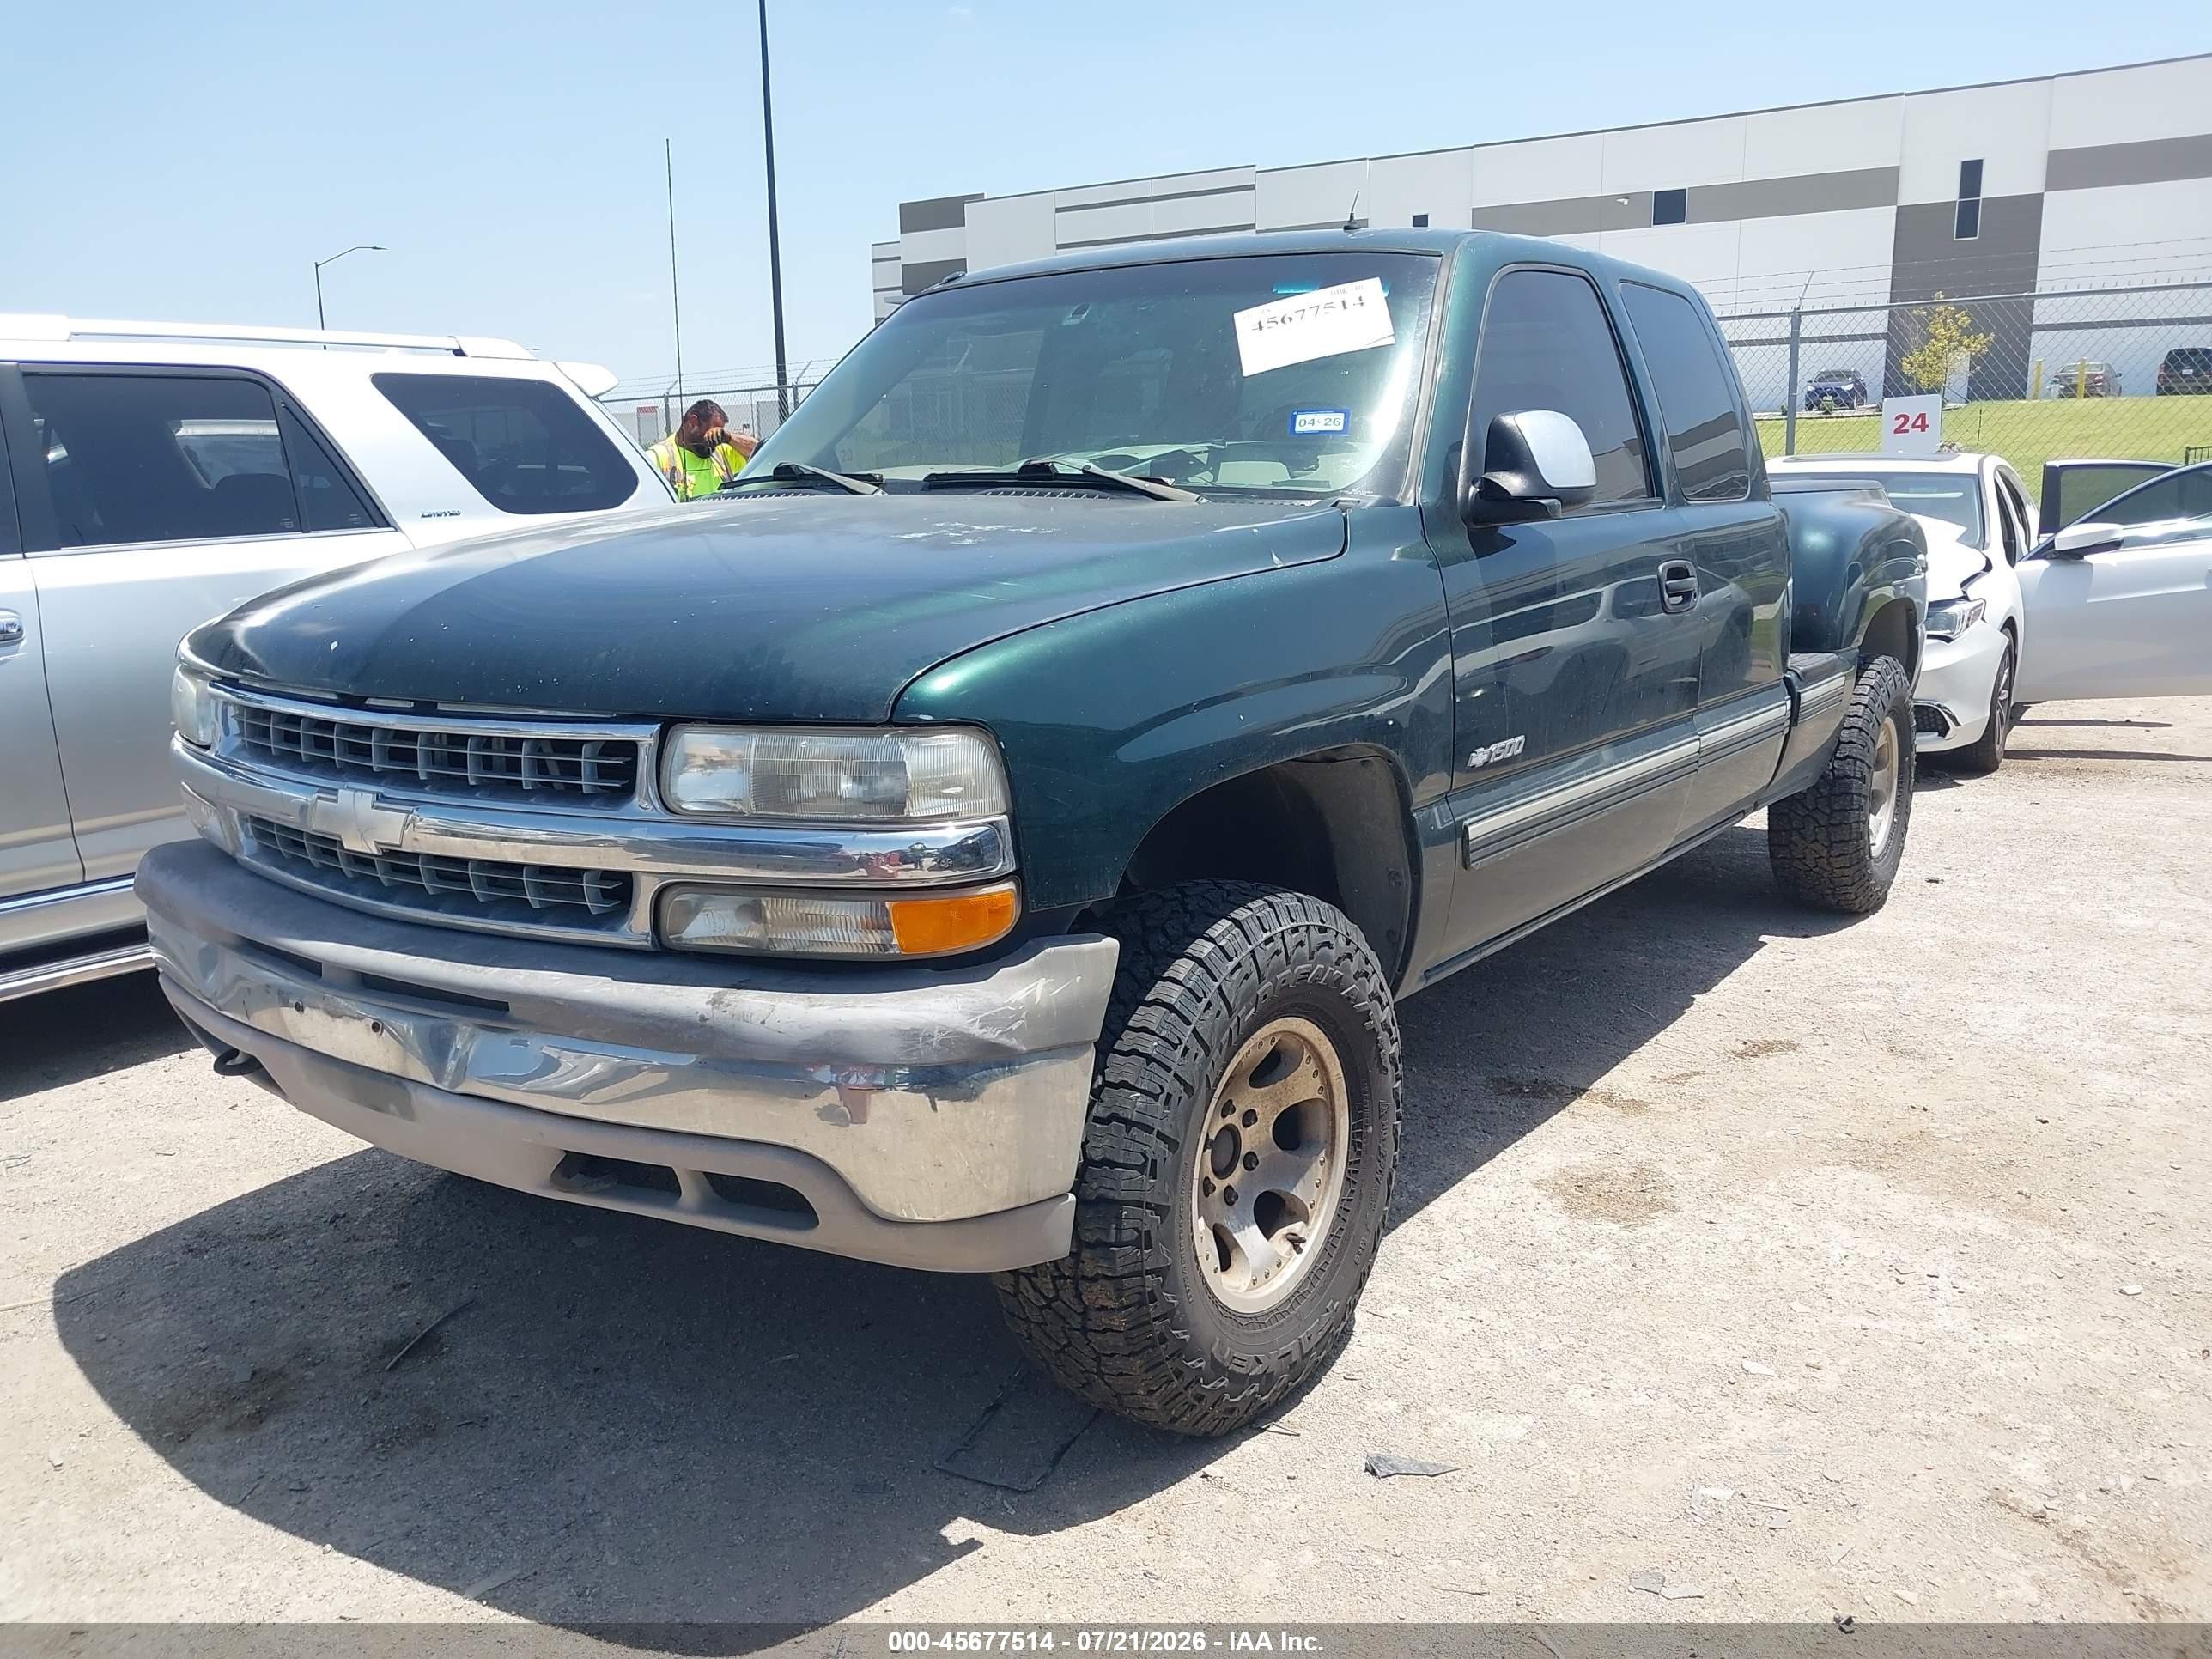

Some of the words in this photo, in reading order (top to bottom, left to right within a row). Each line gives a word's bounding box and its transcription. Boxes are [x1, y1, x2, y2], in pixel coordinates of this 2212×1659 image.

[1252, 295, 1364, 331] 45677514
[1893, 413, 1929, 434] 24
[1488, 736, 1525, 761] 1500
